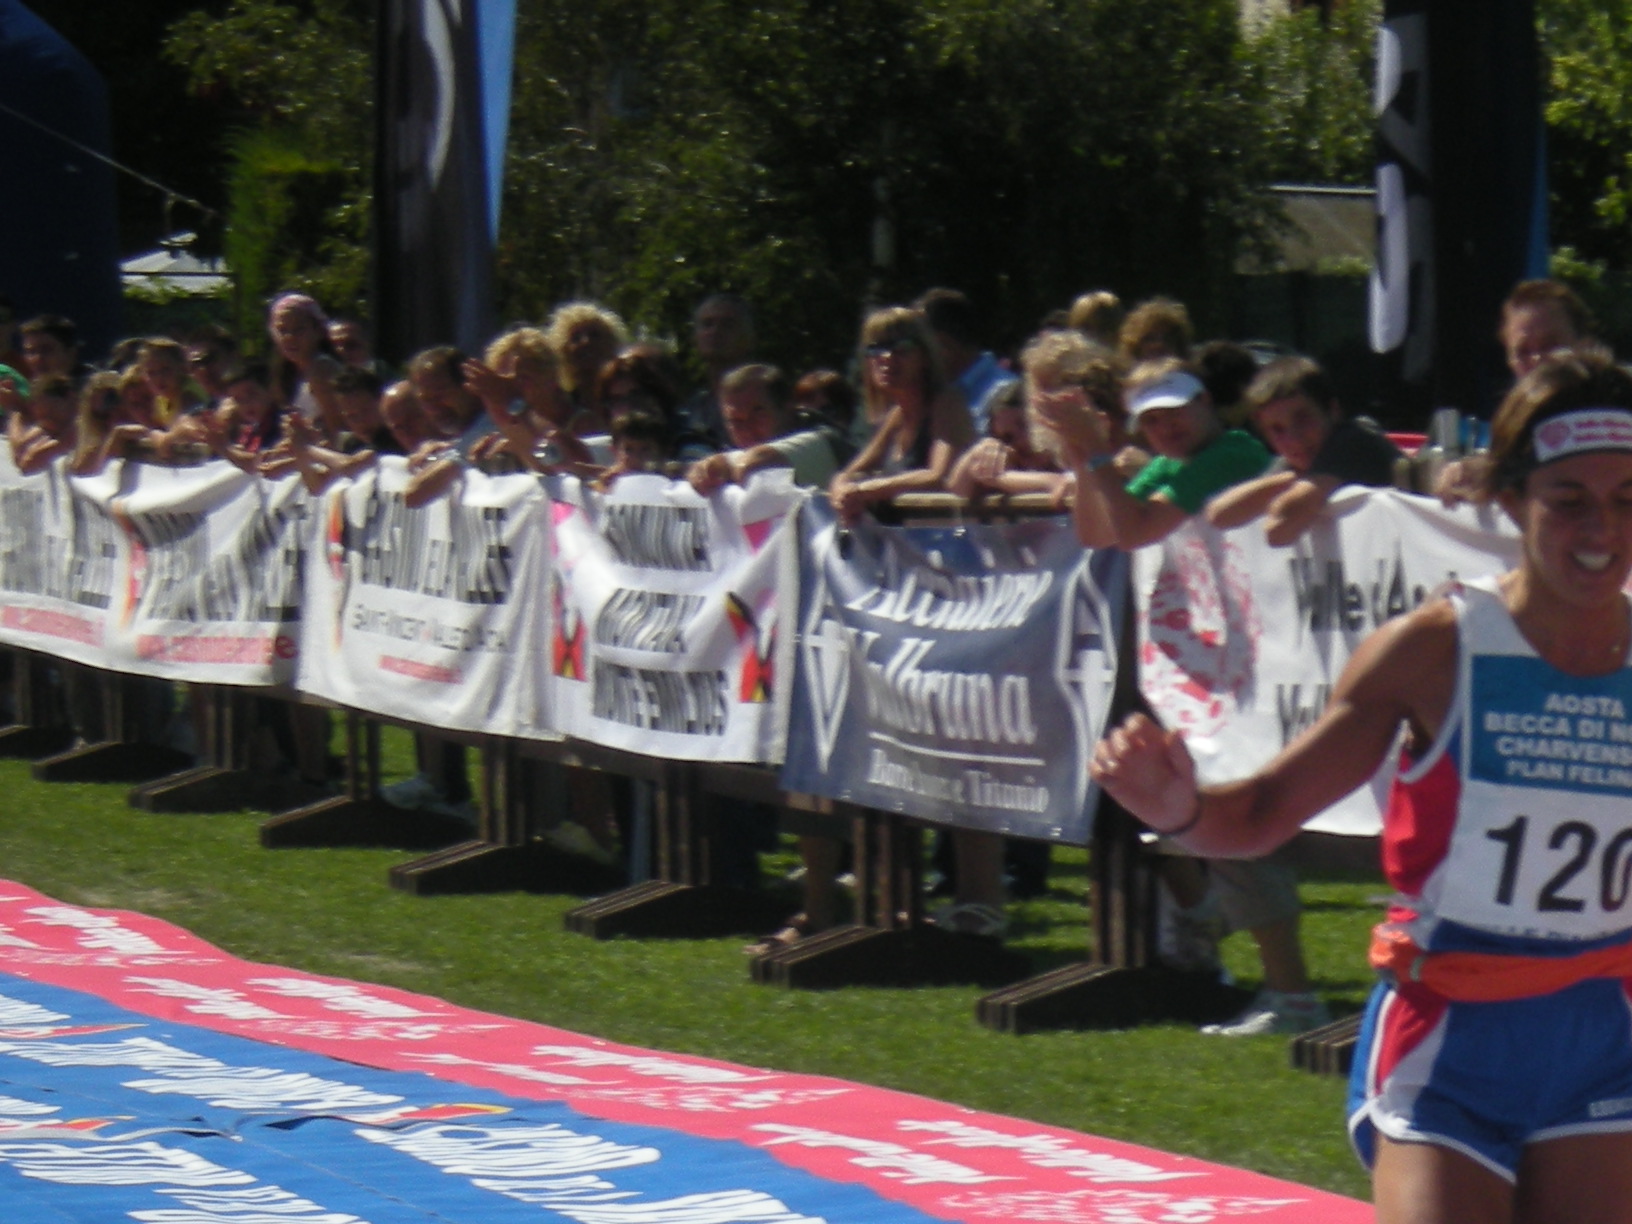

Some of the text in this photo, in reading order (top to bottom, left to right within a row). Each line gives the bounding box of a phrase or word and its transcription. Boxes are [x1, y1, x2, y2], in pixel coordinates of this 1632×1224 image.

[1544, 693, 1625, 719] AOSTA
[1483, 711, 1571, 735] BECCA
[1577, 718, 1605, 739] DI
[1505, 759, 1564, 780] PLAN
